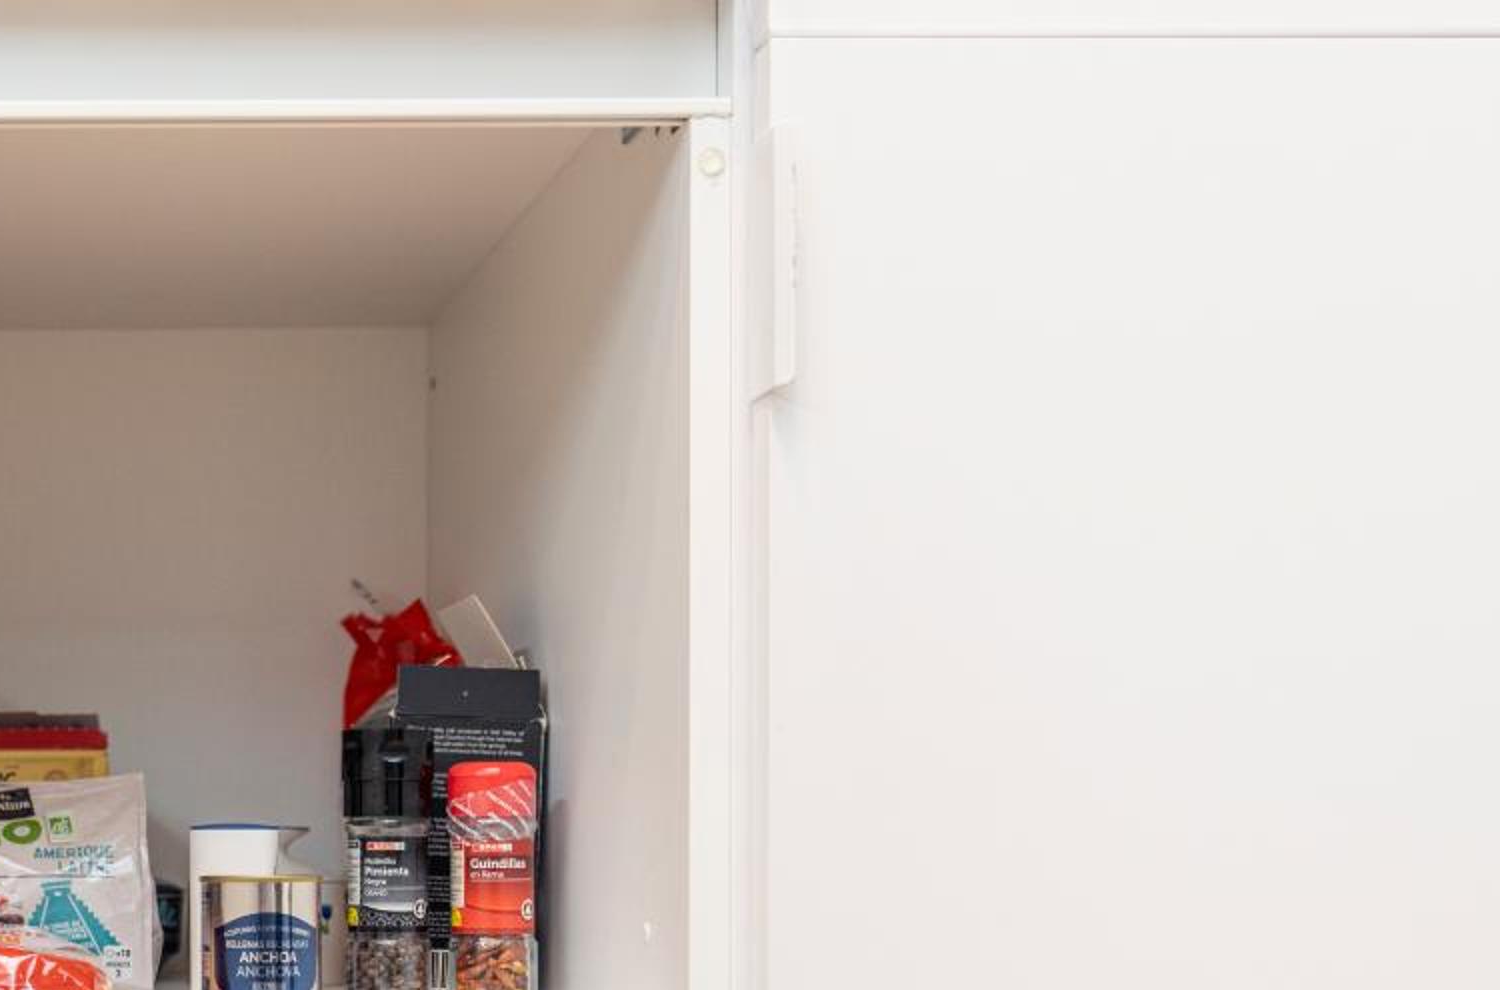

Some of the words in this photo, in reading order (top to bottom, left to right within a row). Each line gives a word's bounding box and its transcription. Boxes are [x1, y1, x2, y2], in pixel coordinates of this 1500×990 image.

[469, 857, 527, 869] Guindillas
[240, 951, 298, 963] ANCHOA
[236, 965, 301, 977] ANCHOVA
